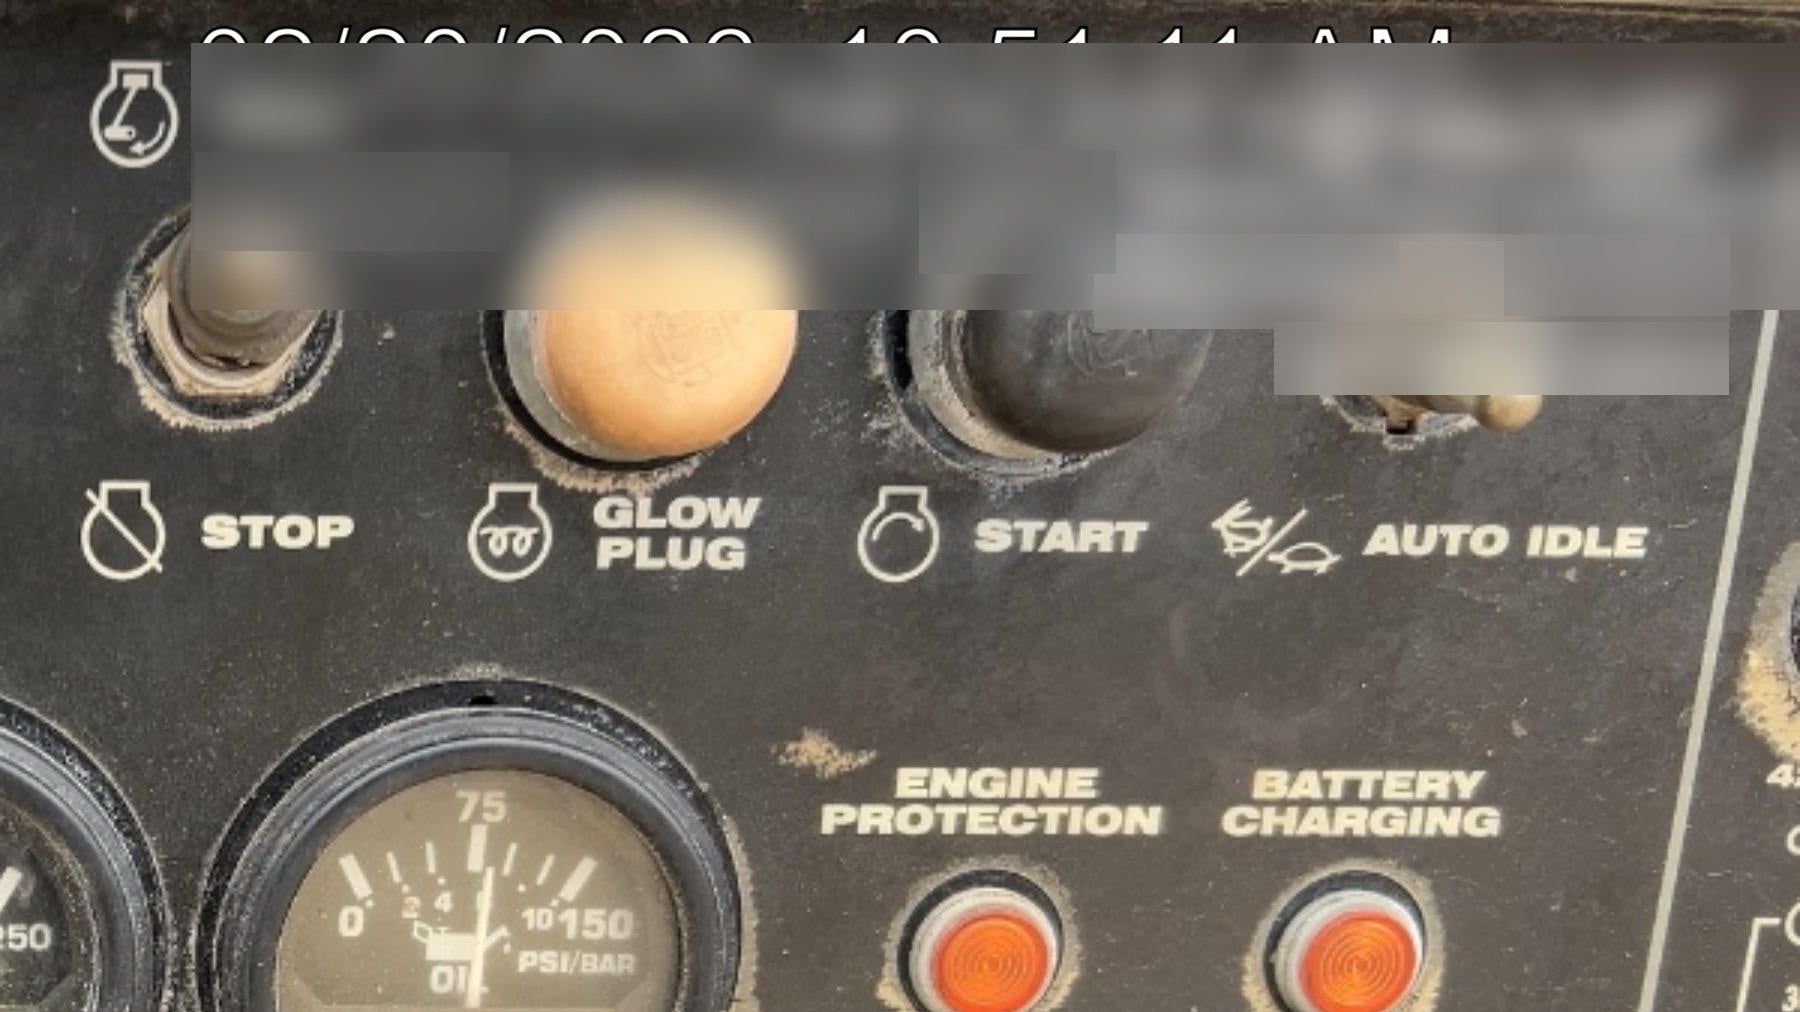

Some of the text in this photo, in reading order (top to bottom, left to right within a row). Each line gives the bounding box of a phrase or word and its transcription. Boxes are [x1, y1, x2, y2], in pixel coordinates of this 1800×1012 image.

[592, 496, 762, 531] GLOW
[200, 513, 356, 551] STOP
[972, 521, 1150, 555] START
[1362, 522, 1650, 560] AUTO IDLE
[596, 535, 747, 571] PLUG
[894, 766, 1102, 800] ENGINE
[1250, 769, 1488, 800] BATTERY
[455, 790, 508, 823] 75
[819, 804, 1163, 837] PROTECTION
[1220, 805, 1502, 839] CHARGING
[433, 890, 453, 914] 4
[521, 906, 555, 932] 10
[337, 905, 365, 938] 0
[557, 907, 635, 941] 150
[517, 949, 637, 976] PSI/BAR
